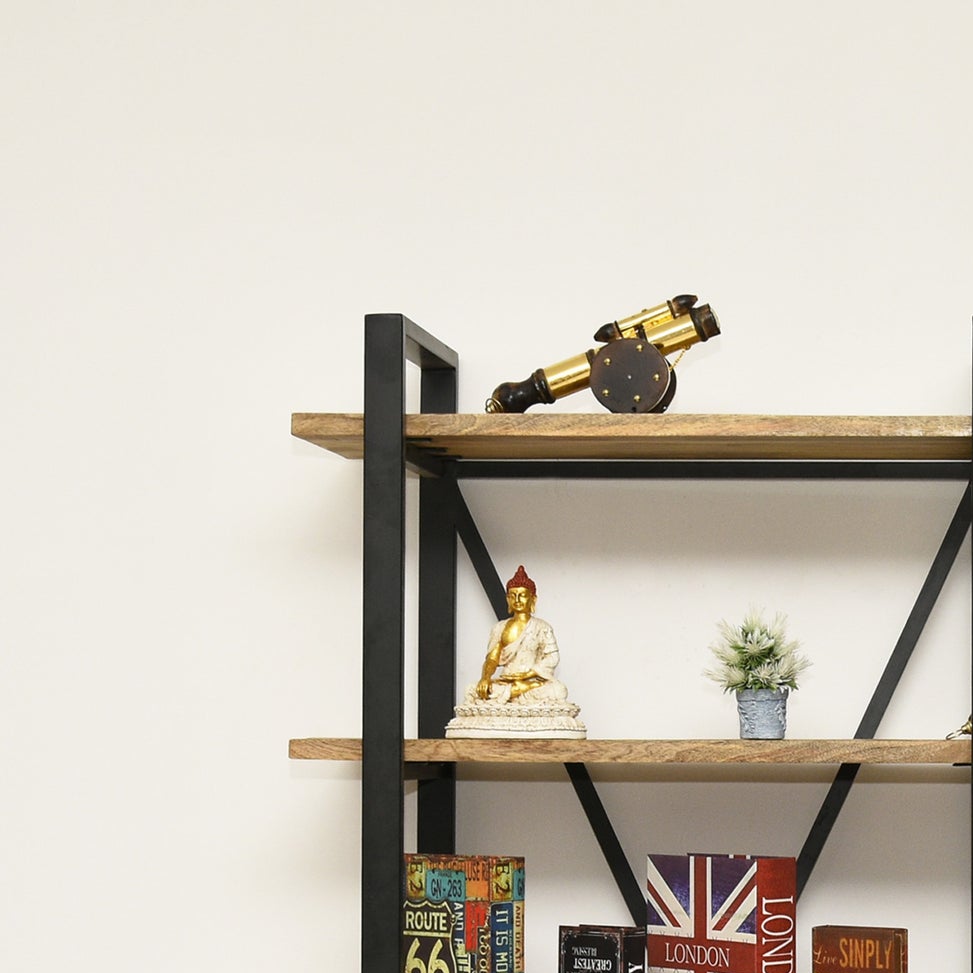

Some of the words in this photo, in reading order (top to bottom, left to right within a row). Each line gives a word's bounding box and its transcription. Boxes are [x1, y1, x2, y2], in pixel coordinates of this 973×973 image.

[405, 910, 448, 931] ROUTE
[495, 910, 509, 924] IT
[495, 930, 509, 946] IS
[664, 942, 730, 968] LONDON
[573, 957, 612, 971] GREATEST
